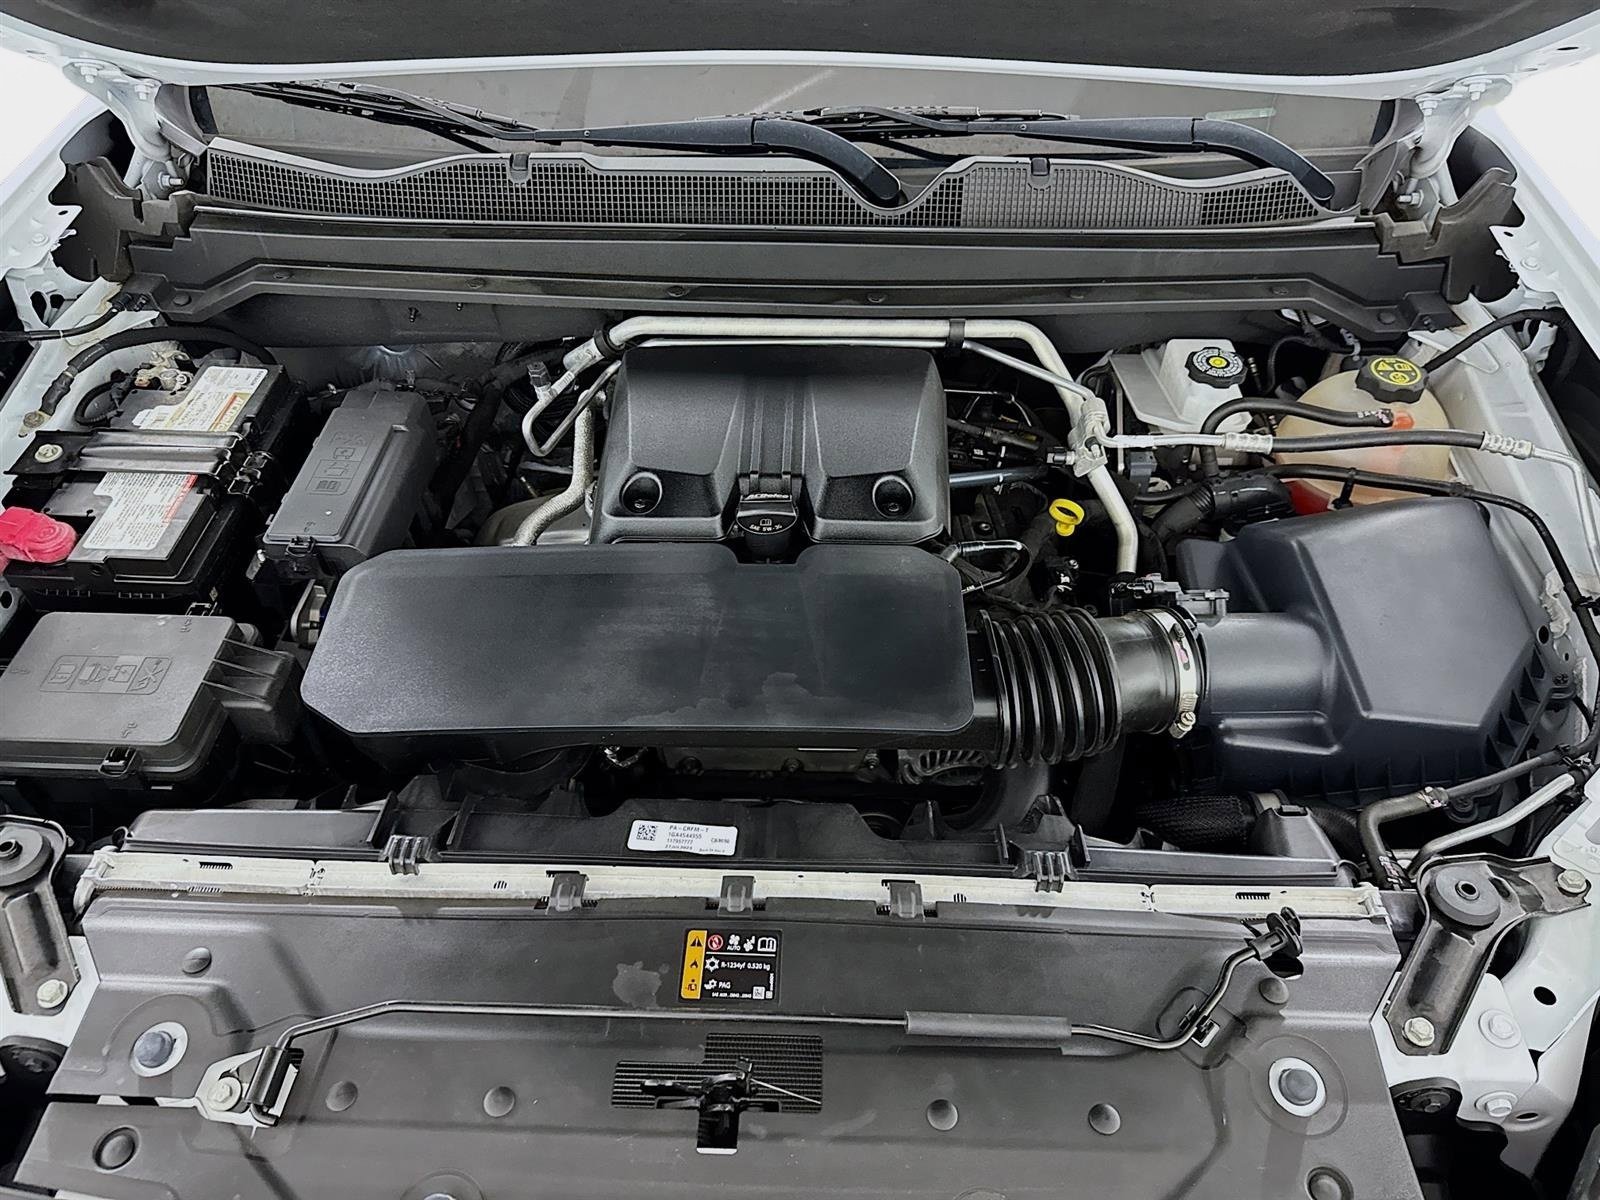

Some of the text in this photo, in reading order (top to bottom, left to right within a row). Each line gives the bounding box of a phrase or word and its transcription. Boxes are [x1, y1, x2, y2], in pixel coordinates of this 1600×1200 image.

[744, 493, 789, 501] ACDelco
[720, 961, 771, 972] R-1234yf 0.520 kg
[718, 981, 731, 989] PAG
